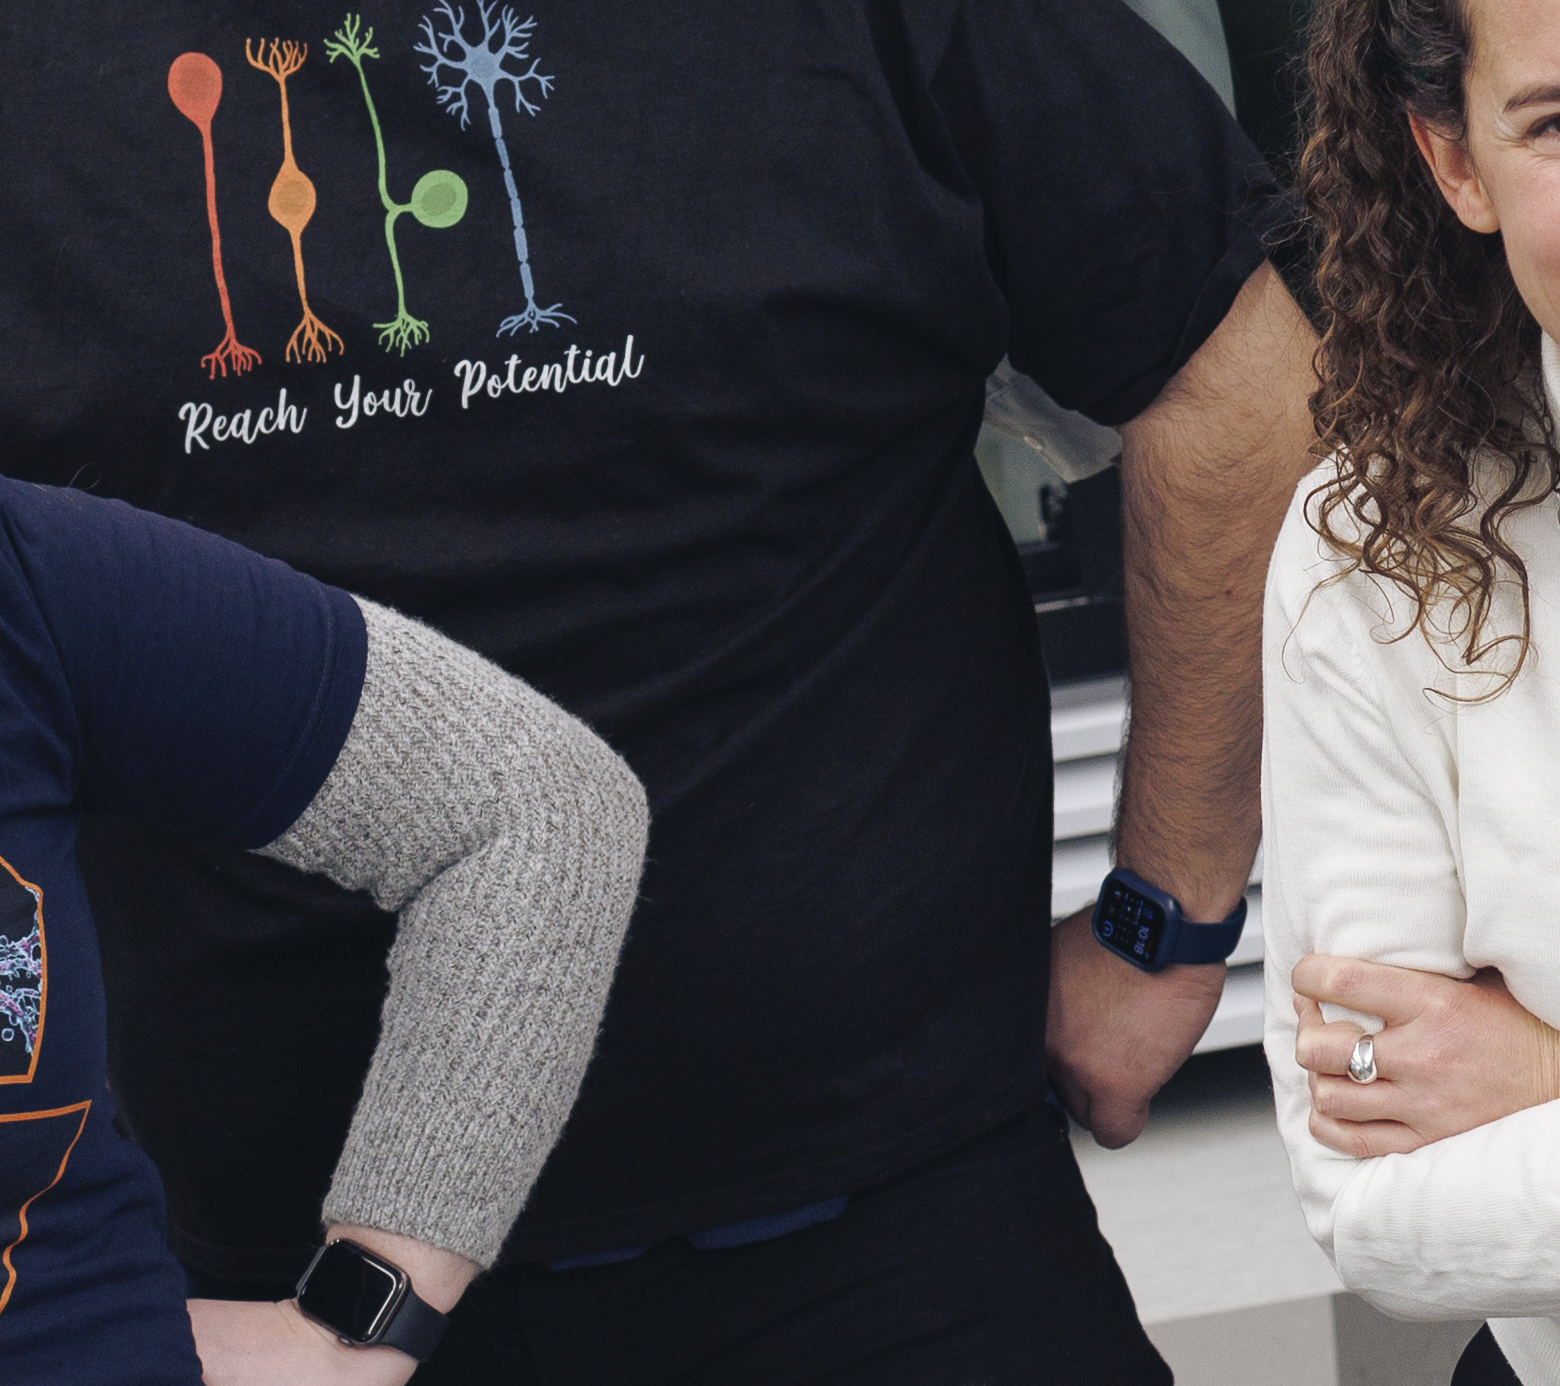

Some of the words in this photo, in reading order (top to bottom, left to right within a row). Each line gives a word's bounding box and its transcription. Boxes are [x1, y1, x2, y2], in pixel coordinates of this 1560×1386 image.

[178, 388, 308, 454] Reach
[334, 374, 433, 429] Your
[453, 334, 645, 410] Potential
